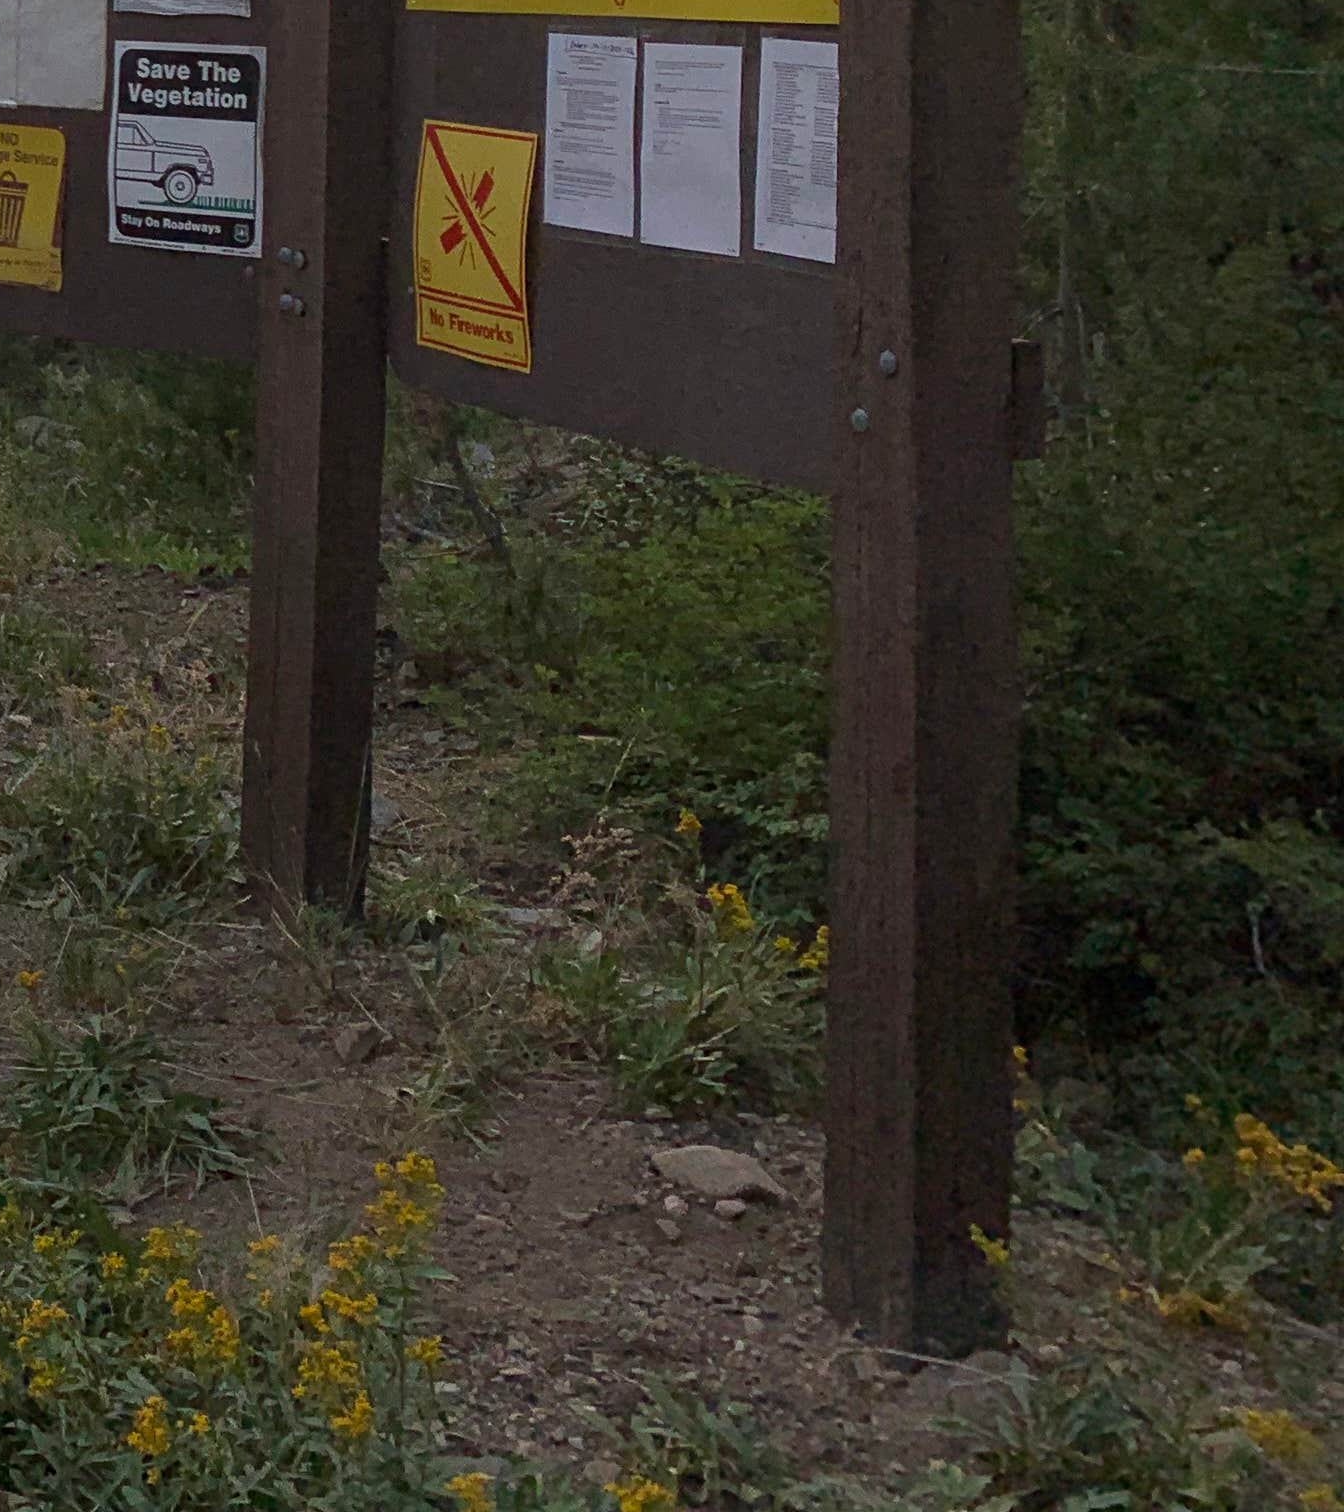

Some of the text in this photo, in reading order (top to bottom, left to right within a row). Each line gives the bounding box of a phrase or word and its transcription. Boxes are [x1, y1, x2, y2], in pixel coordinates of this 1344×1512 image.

[136, 57, 242, 84] Save The
[127, 82, 249, 110] Vegetation
[14, 149, 59, 167] Service
[120, 213, 222, 235] Stay On Roadways
[429, 307, 515, 345] No Fireworks
